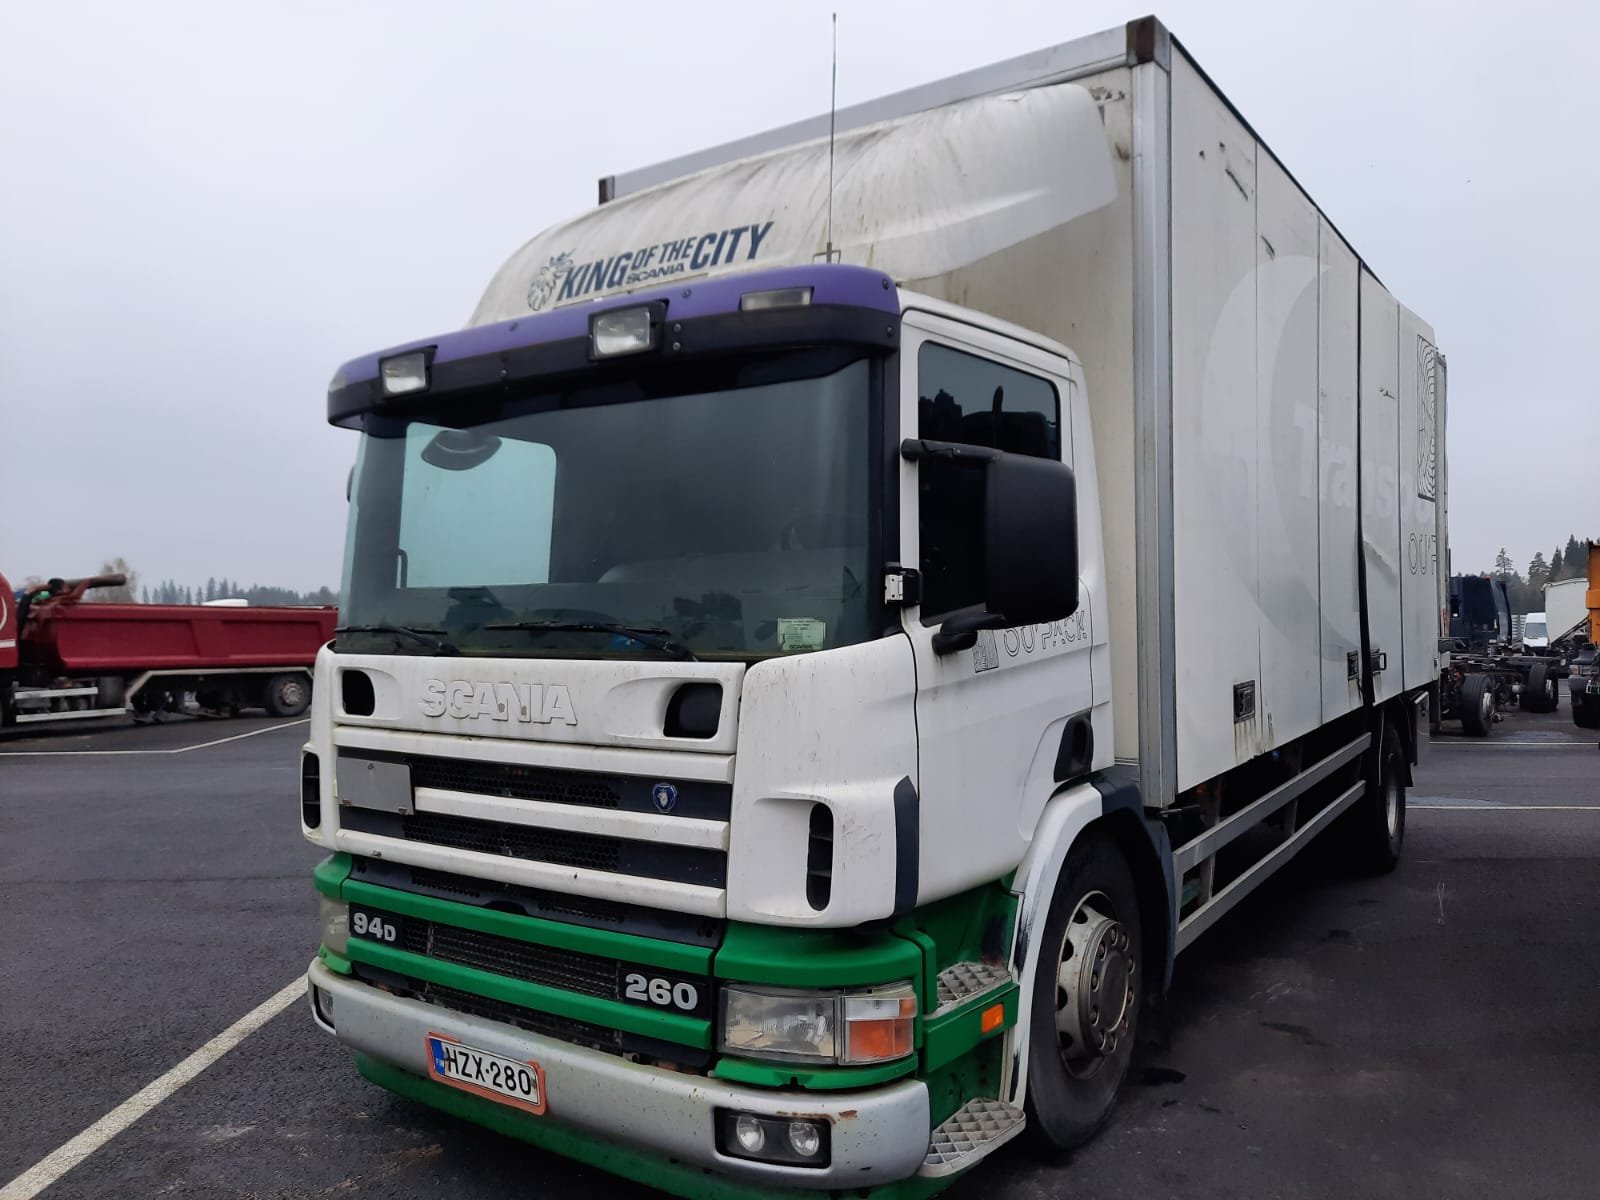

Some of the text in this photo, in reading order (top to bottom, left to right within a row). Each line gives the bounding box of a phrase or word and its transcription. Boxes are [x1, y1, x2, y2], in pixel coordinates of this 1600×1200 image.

[556, 221, 774, 301] KING OF THE CITY
[625, 262, 685, 285] SCANIA
[420, 678, 578, 726] SCANIA
[352, 911, 397, 943] 94D
[624, 972, 698, 1011] 260
[445, 1046, 532, 1096] HZX-280
